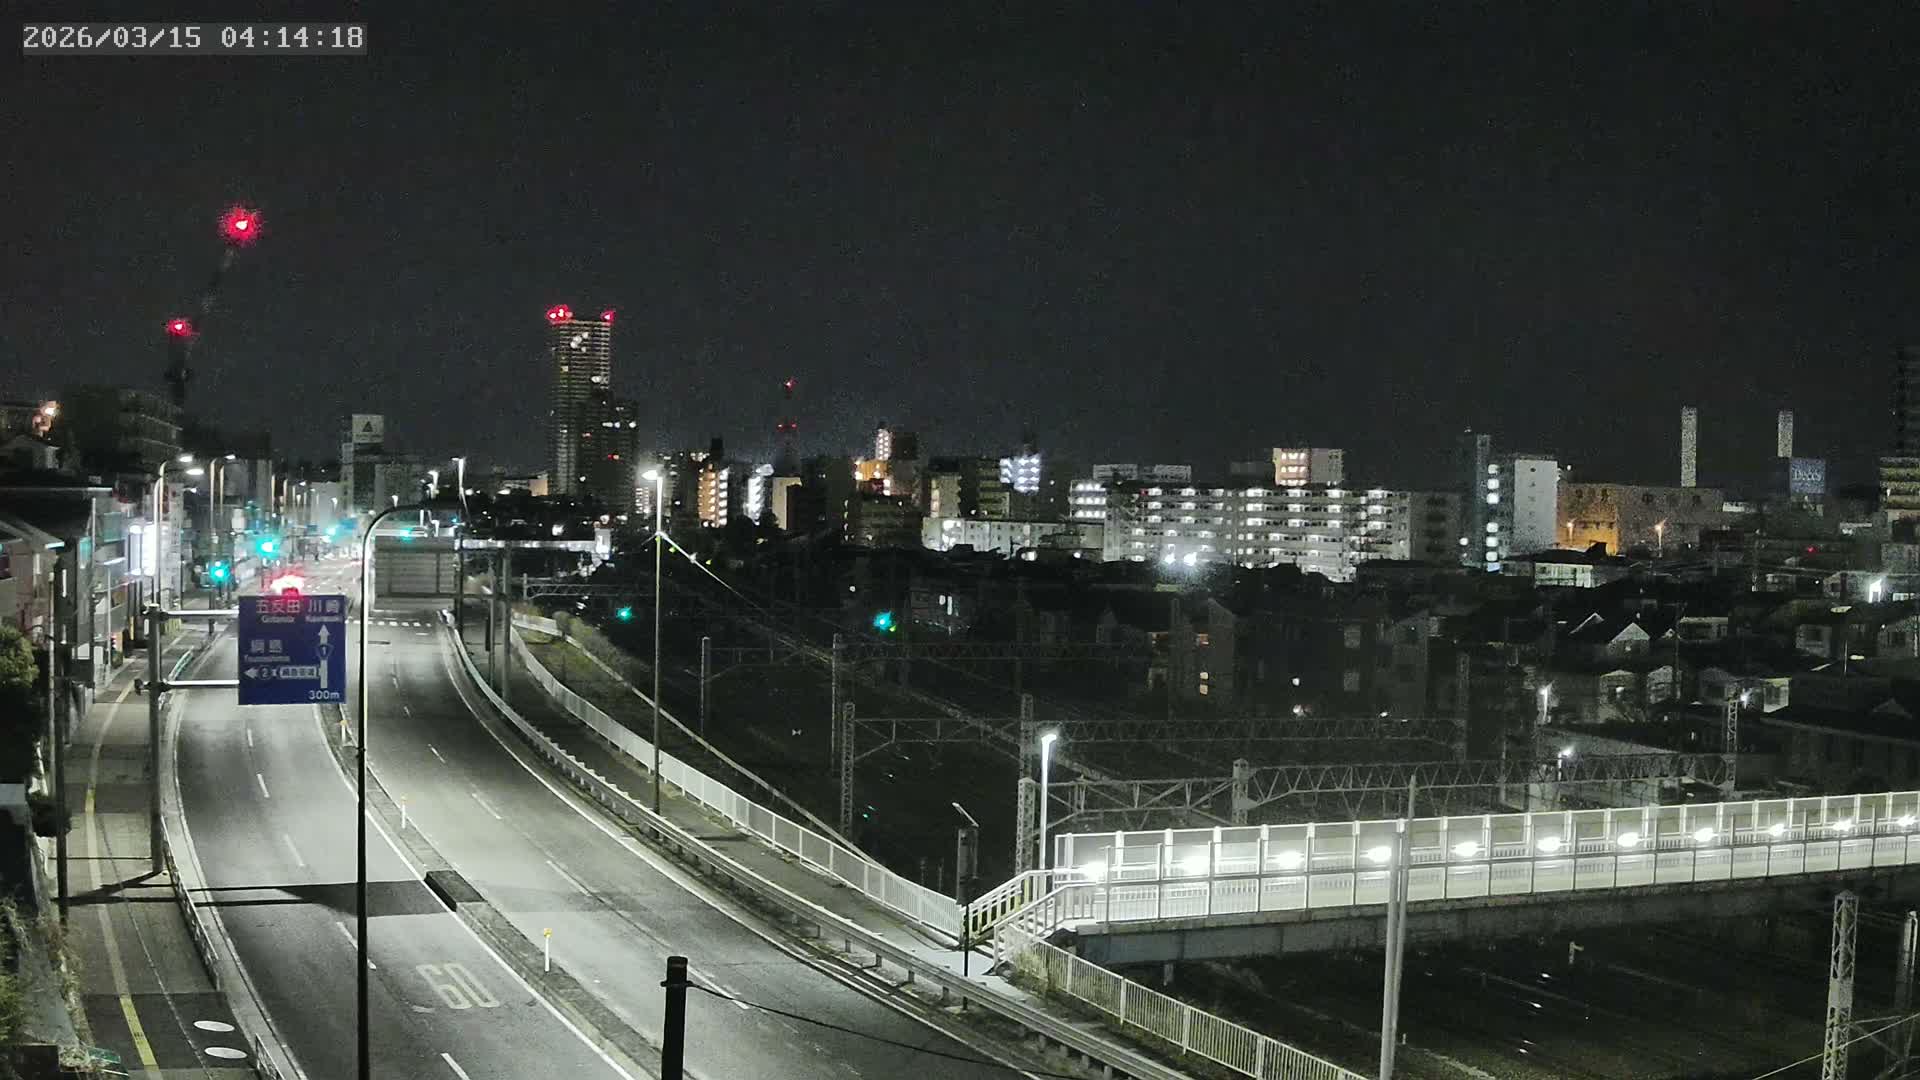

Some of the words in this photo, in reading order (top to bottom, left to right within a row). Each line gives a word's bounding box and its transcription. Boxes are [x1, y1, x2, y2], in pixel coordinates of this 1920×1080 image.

[256, 599, 300, 614] 五反田
[309, 690, 340, 700] 300m
[416, 963, 500, 1010] 60
